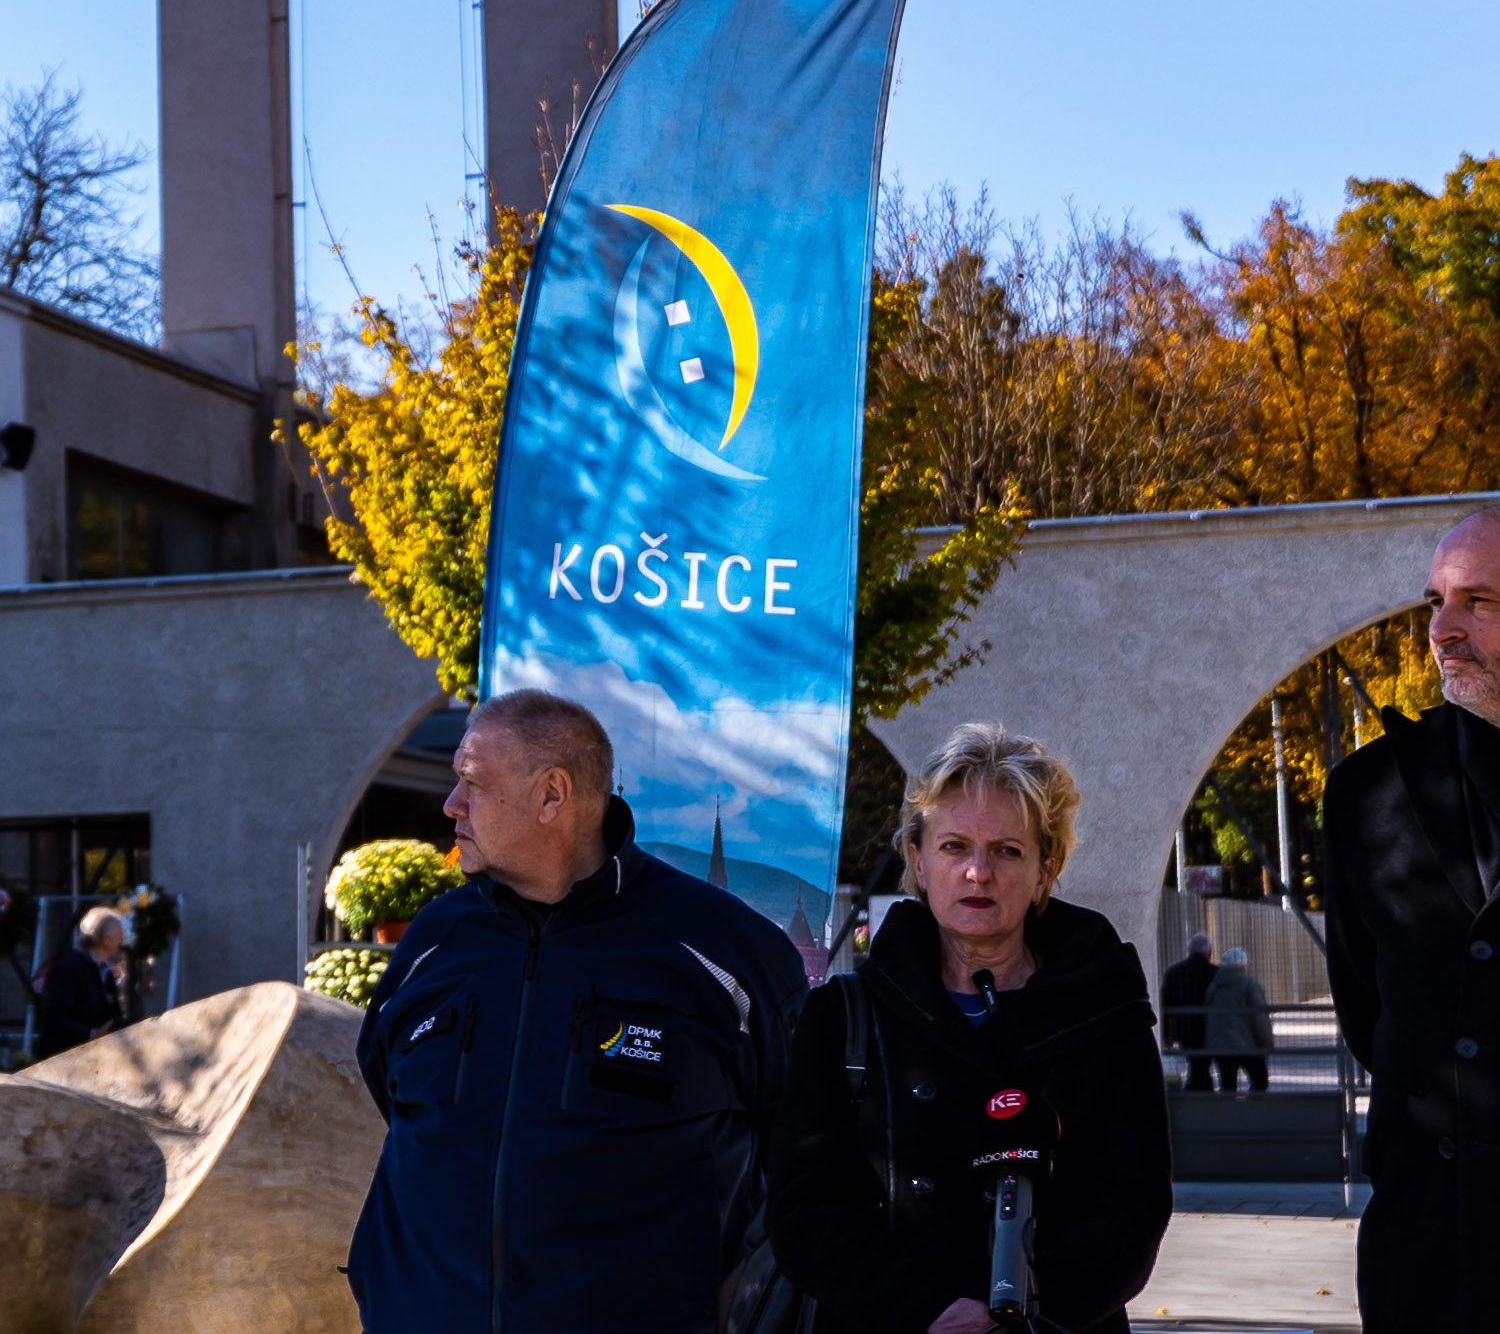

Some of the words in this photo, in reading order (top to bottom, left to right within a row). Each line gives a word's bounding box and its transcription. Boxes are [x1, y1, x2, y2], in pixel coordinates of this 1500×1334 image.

[549, 530, 798, 616] KOŠICE
[627, 1025, 663, 1039] DPMK
[620, 1046, 662, 1062] KOŠICE
[991, 1093, 1021, 1111] KE
